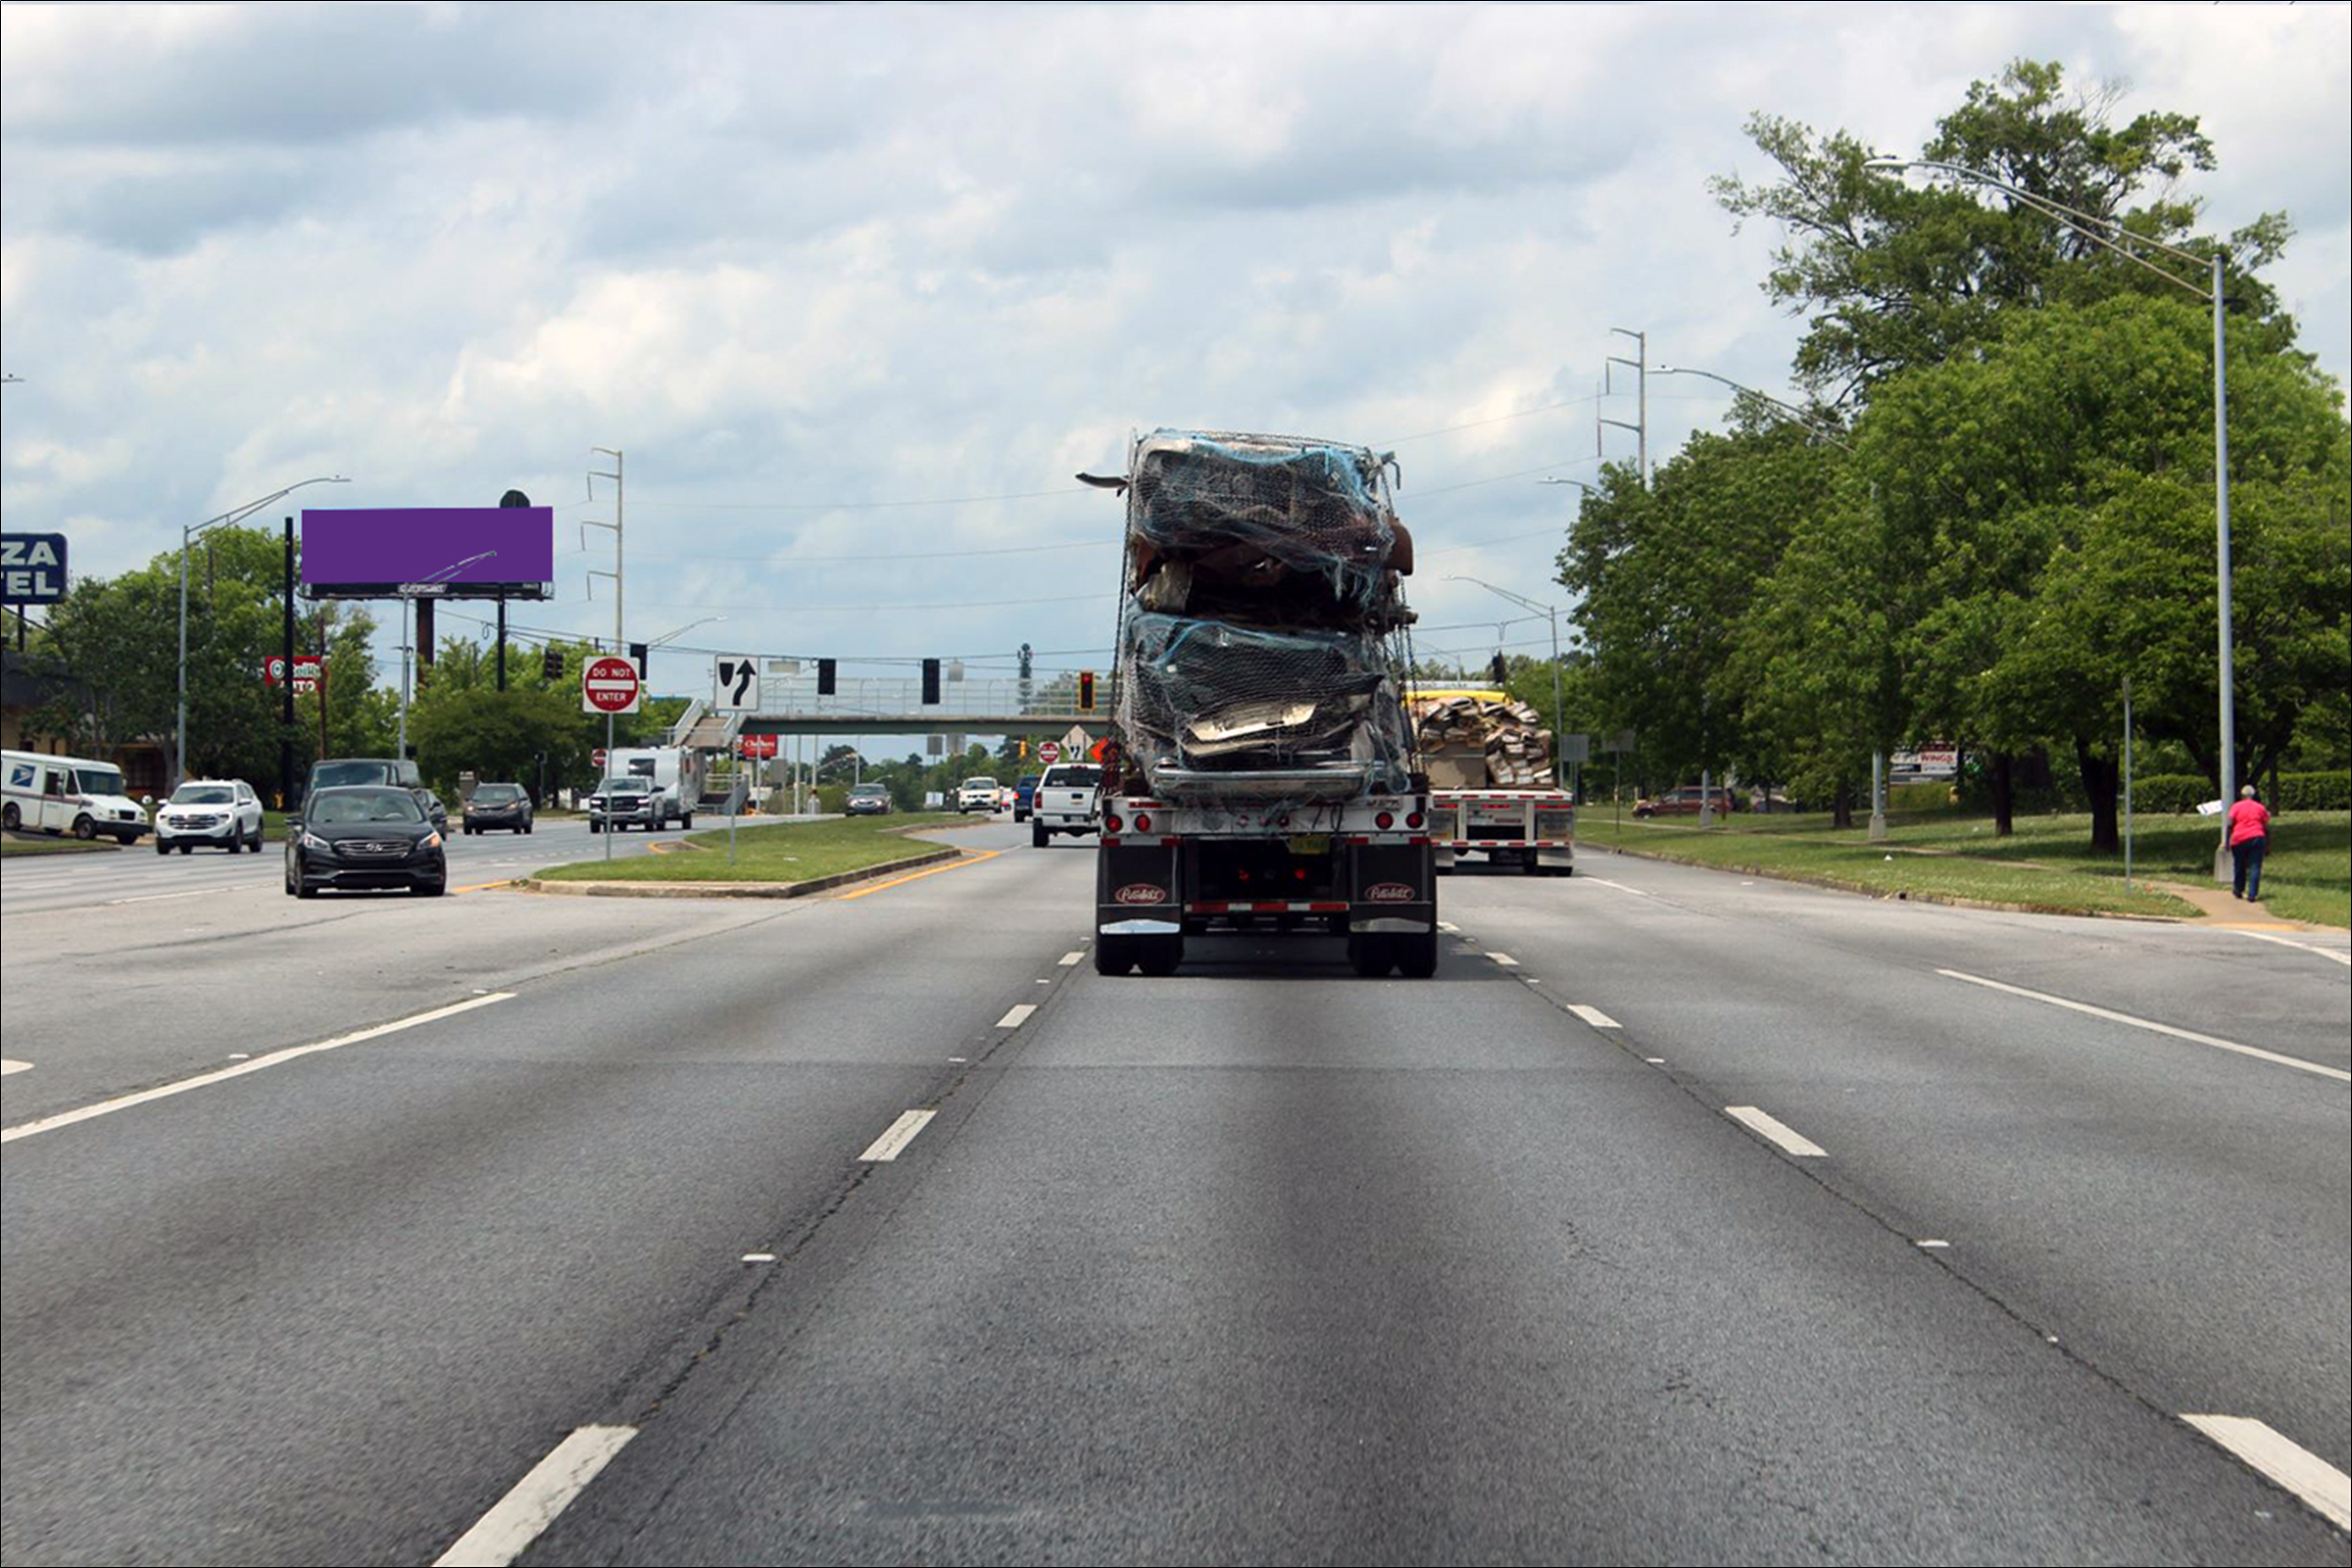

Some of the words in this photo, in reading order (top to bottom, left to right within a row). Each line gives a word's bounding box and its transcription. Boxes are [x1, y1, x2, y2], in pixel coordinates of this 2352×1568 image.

[1, 571, 59, 595] EL
[593, 667, 607, 677] DO
[612, 667, 630, 677] NOT
[597, 692, 626, 702] ENTER
[1921, 753, 1954, 763] WINGS
